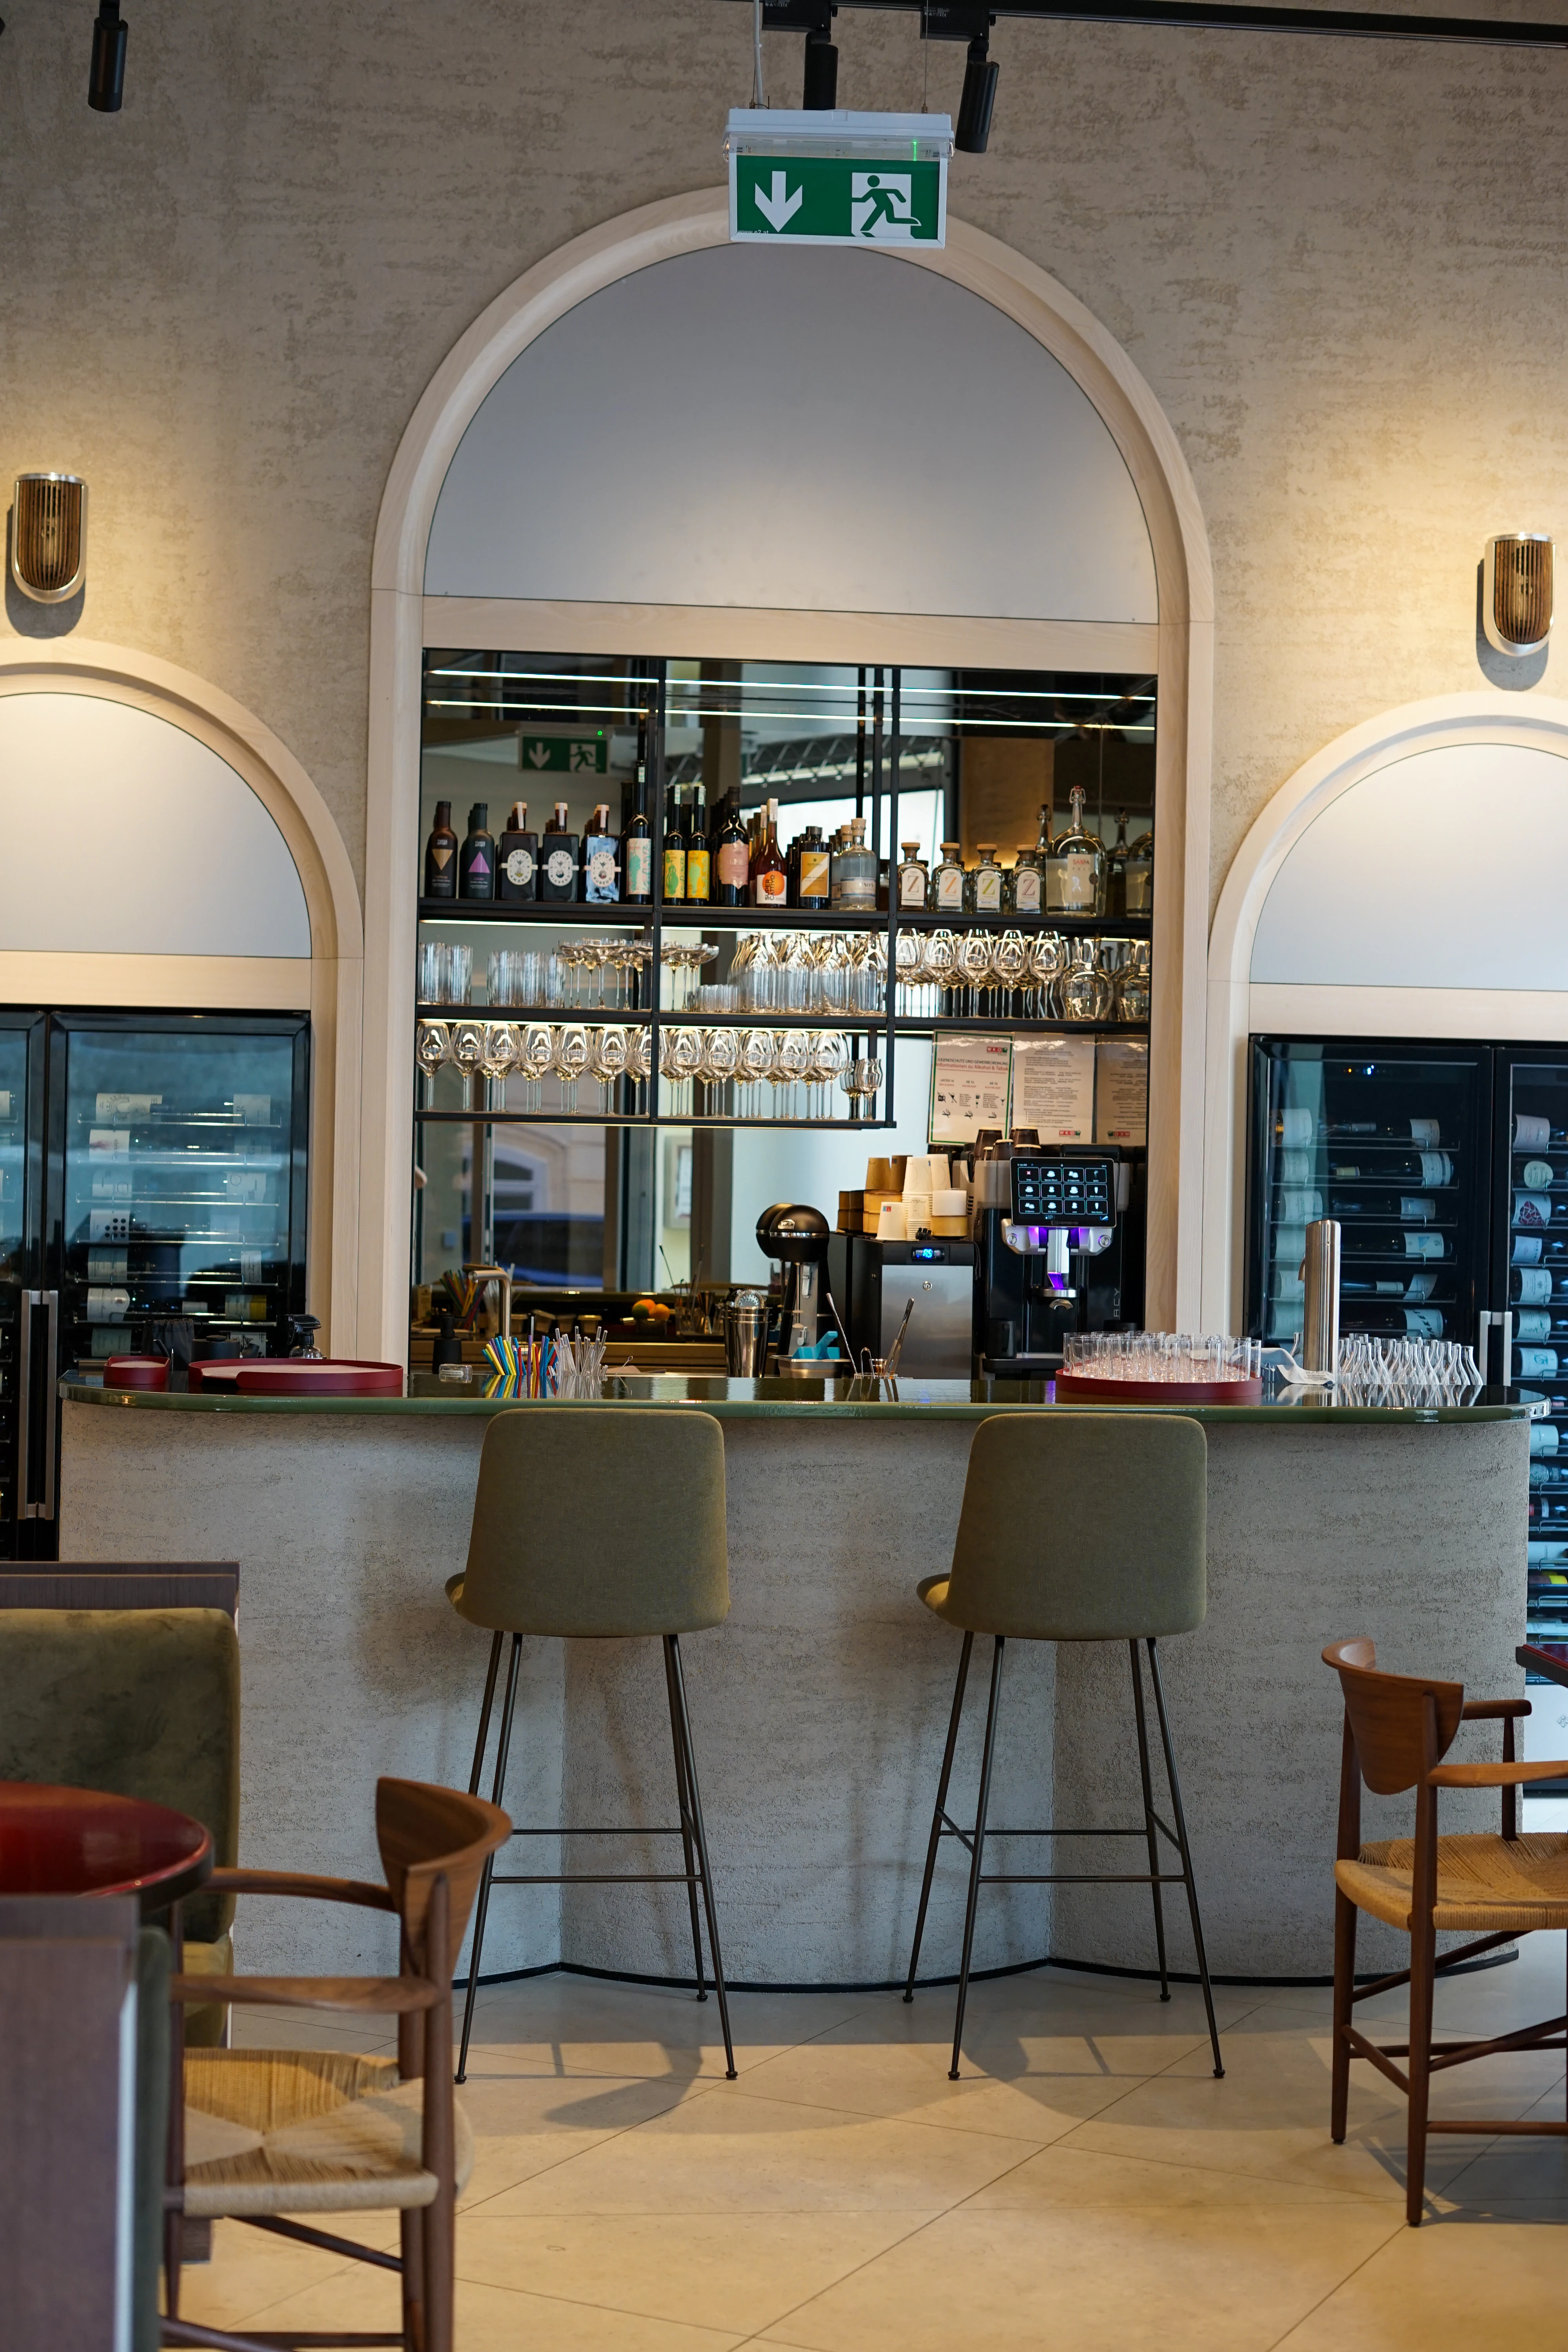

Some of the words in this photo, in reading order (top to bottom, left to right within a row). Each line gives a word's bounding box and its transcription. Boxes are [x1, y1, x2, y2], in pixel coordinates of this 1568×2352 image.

[907, 875, 919, 893] Z
[945, 876, 956, 893] Z
[982, 878, 995, 895] Z
[1022, 878, 1035, 896] Z
